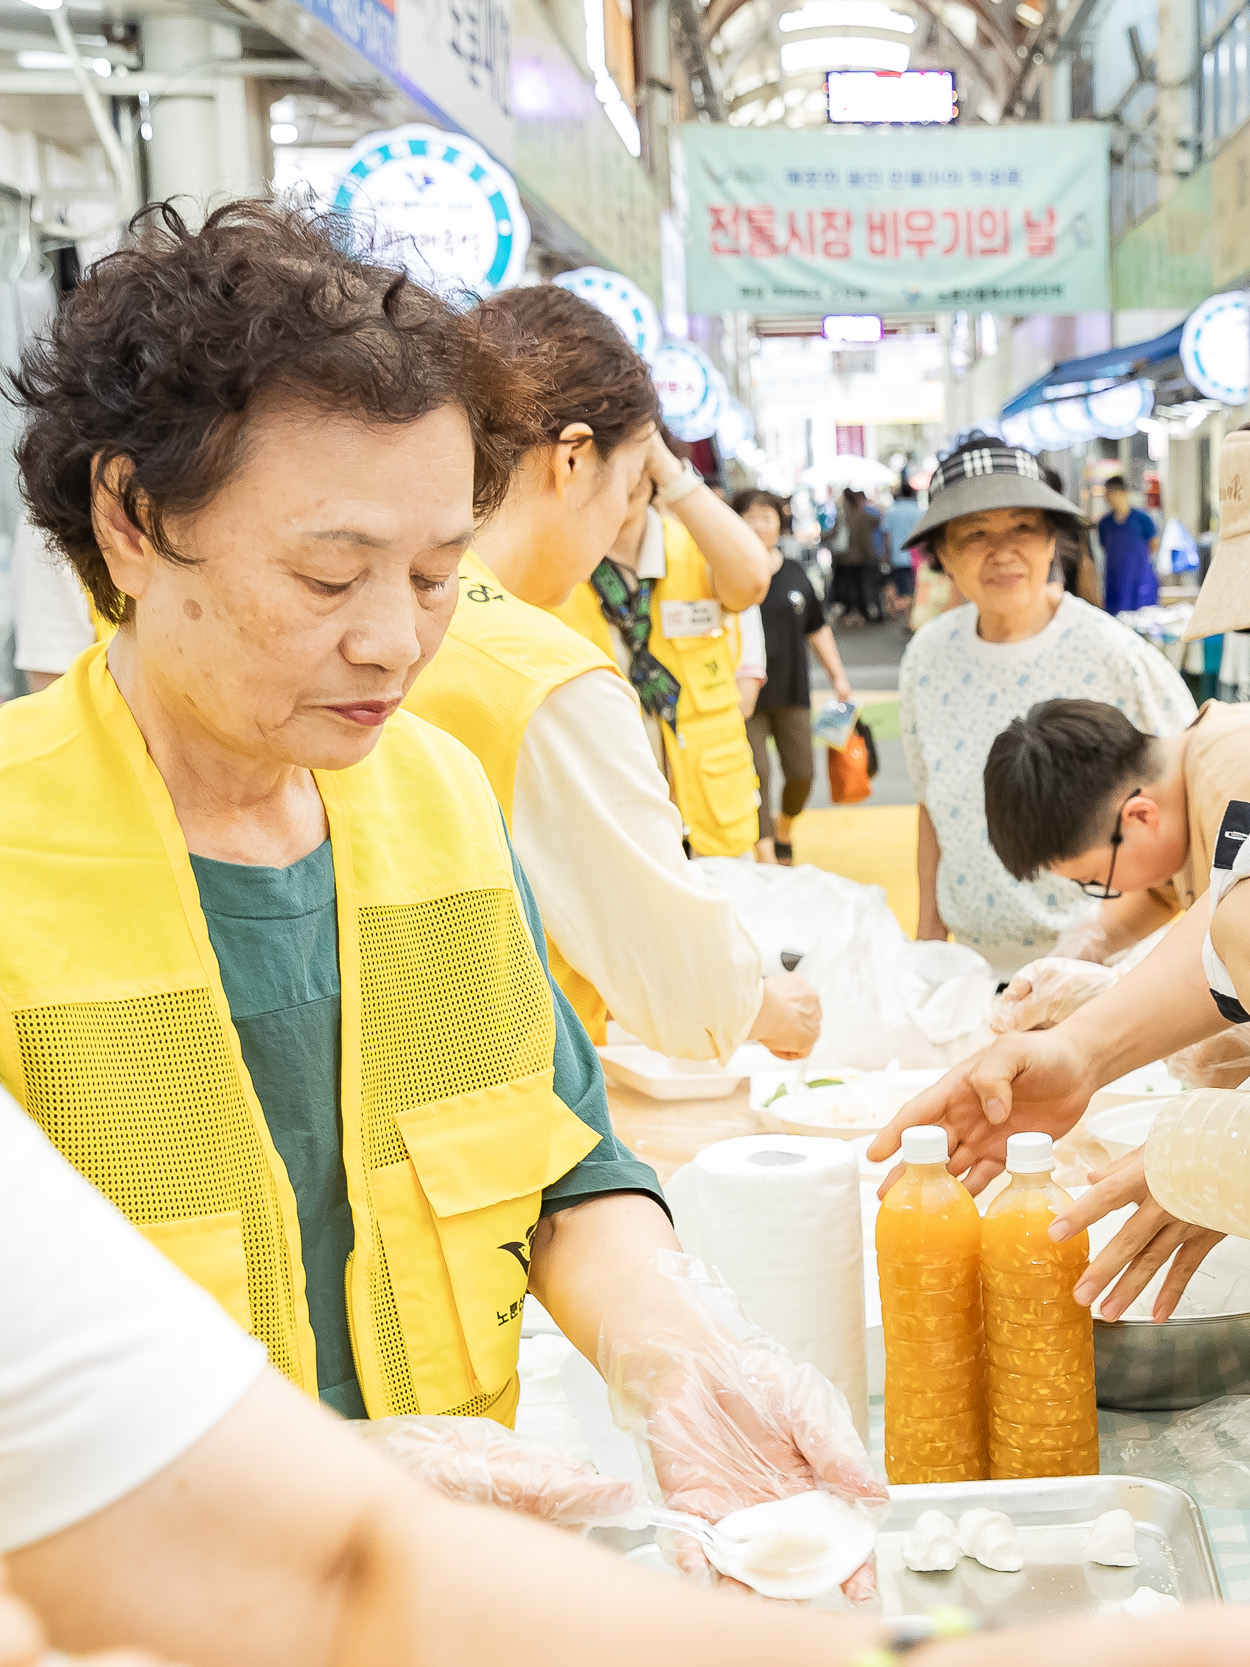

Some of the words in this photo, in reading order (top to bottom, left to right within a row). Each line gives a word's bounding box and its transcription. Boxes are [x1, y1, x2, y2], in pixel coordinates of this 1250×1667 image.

[707, 204, 852, 259] 전통시장
[865, 208, 1009, 260] 비우기의
[1025, 205, 1057, 258] 날
